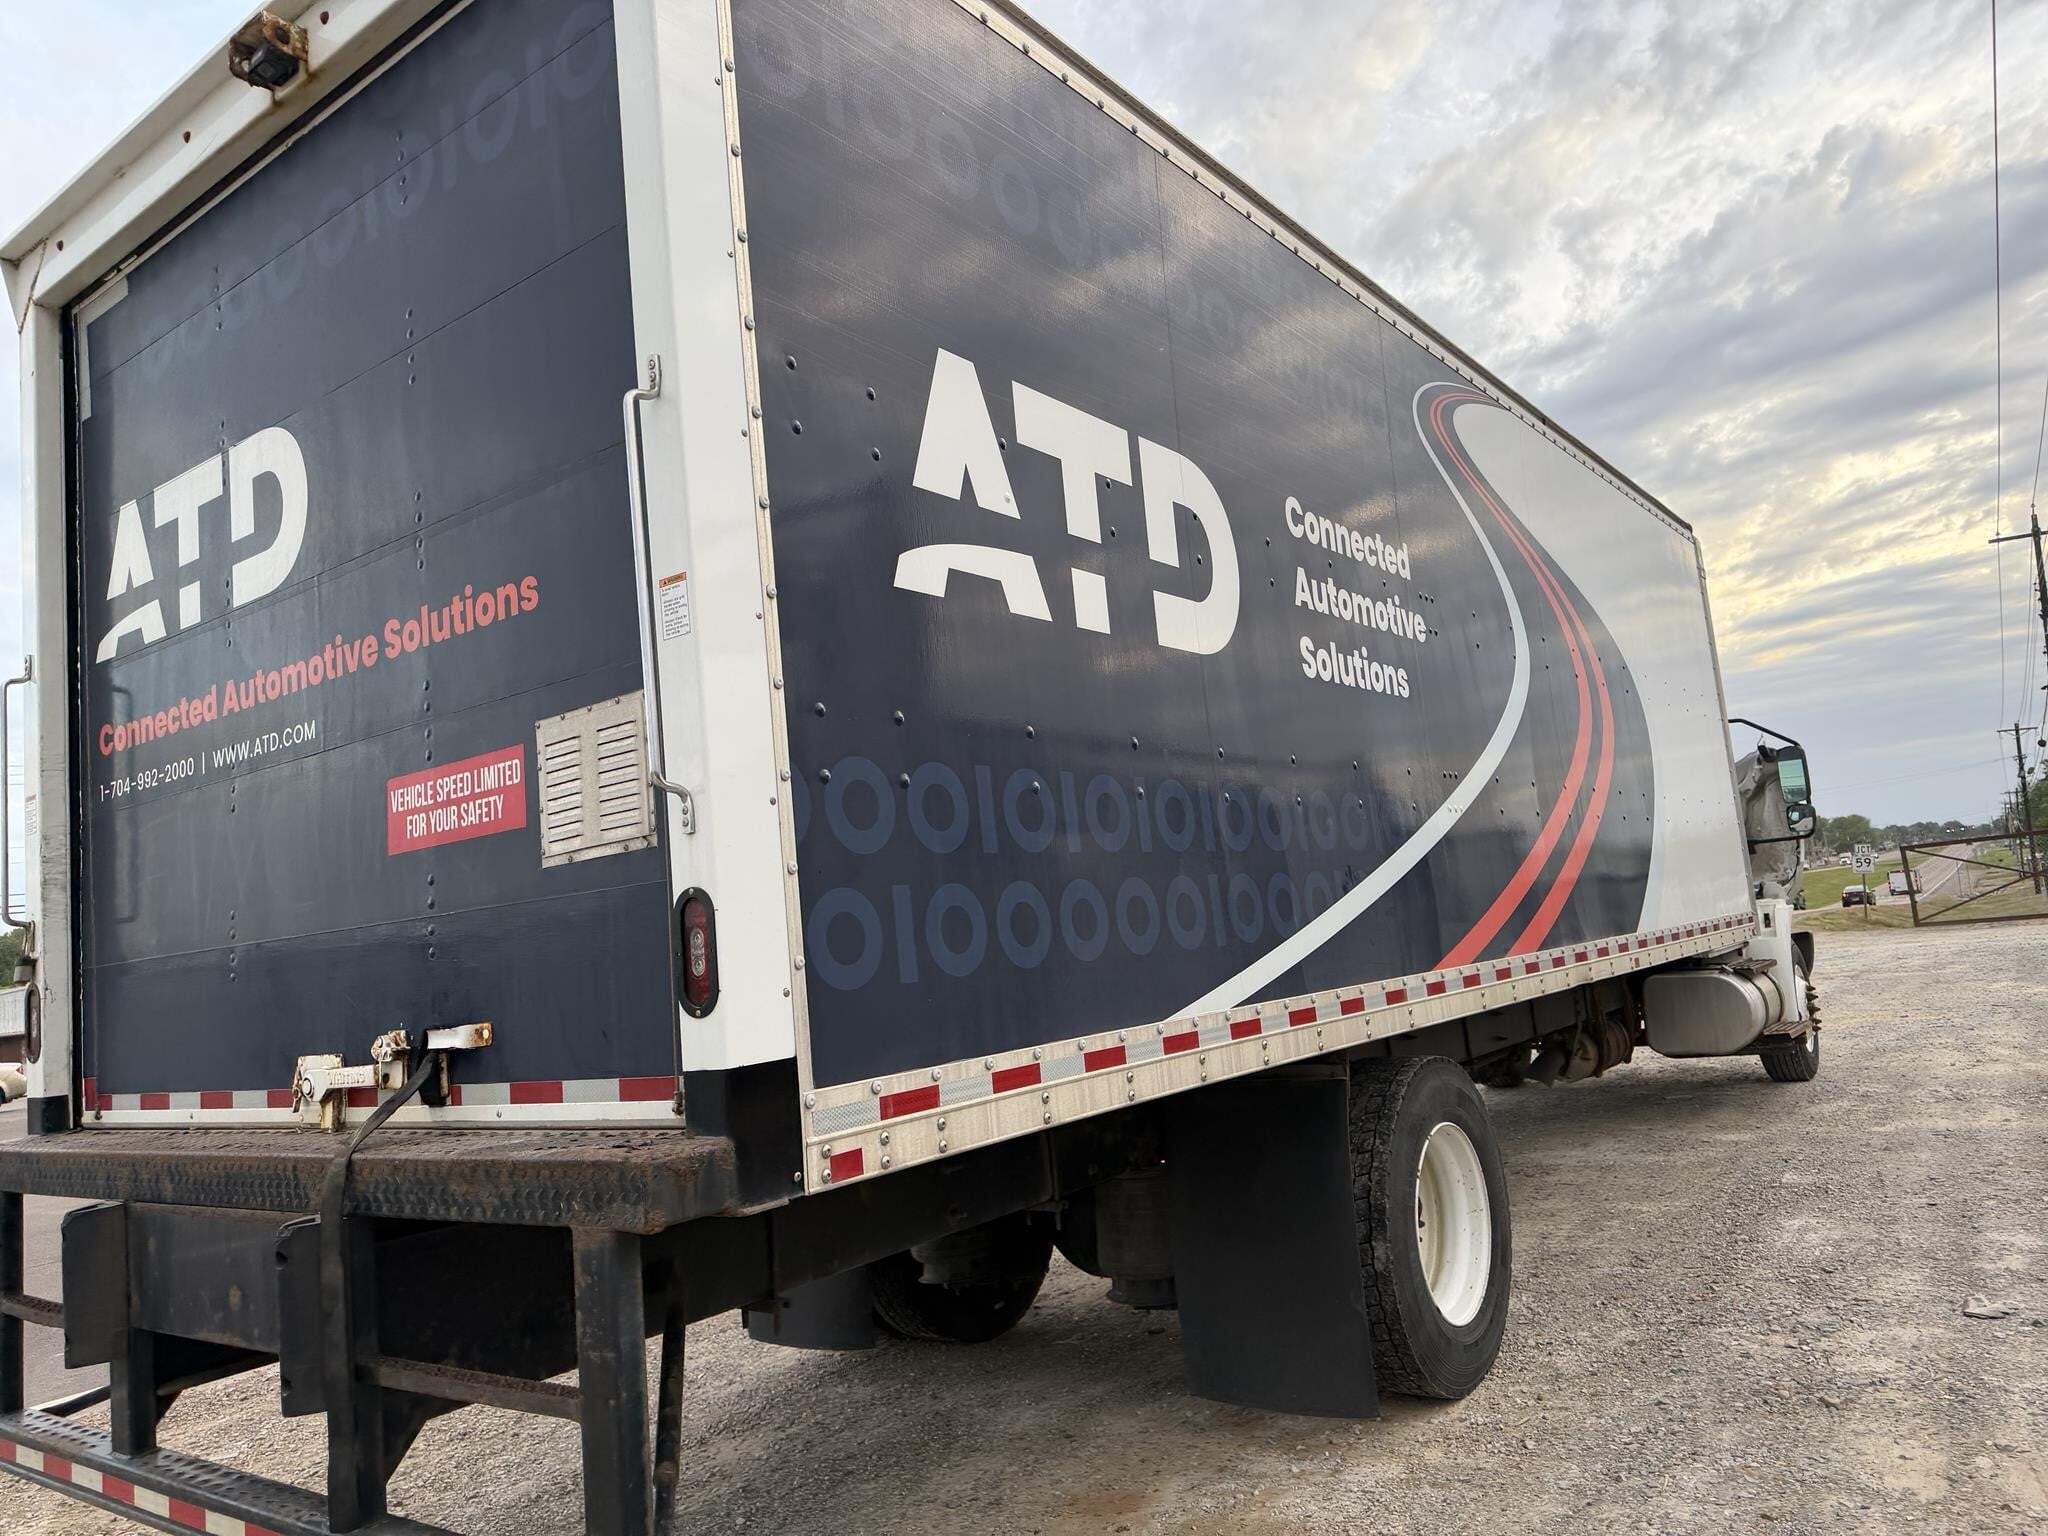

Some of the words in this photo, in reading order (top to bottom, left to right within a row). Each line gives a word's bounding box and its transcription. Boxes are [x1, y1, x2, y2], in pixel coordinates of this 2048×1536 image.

[894, 347, 1240, 655] ATD
[1285, 496, 1411, 580] Connected
[95, 426, 308, 663] ATD
[1295, 566, 1427, 643] Automotive
[99, 684, 218, 756] Connected
[222, 634, 378, 717] Automotive
[384, 575, 539, 660] Solutions
[1300, 635, 1410, 698] Solutions
[100, 757, 195, 802] 1-704-992-2000
[212, 719, 316, 768] WWW.ATD.COM
[390, 781, 434, 813] VEHICLE
[436, 771, 471, 802] SPEED
[474, 758, 520, 793] LIMITED
[406, 812, 427, 839] FOR
[429, 805, 459, 834] YOUR
[461, 794, 504, 827] SAFETY
[1856, 846, 1871, 854] JCT
[1855, 857, 1872, 868] 59
